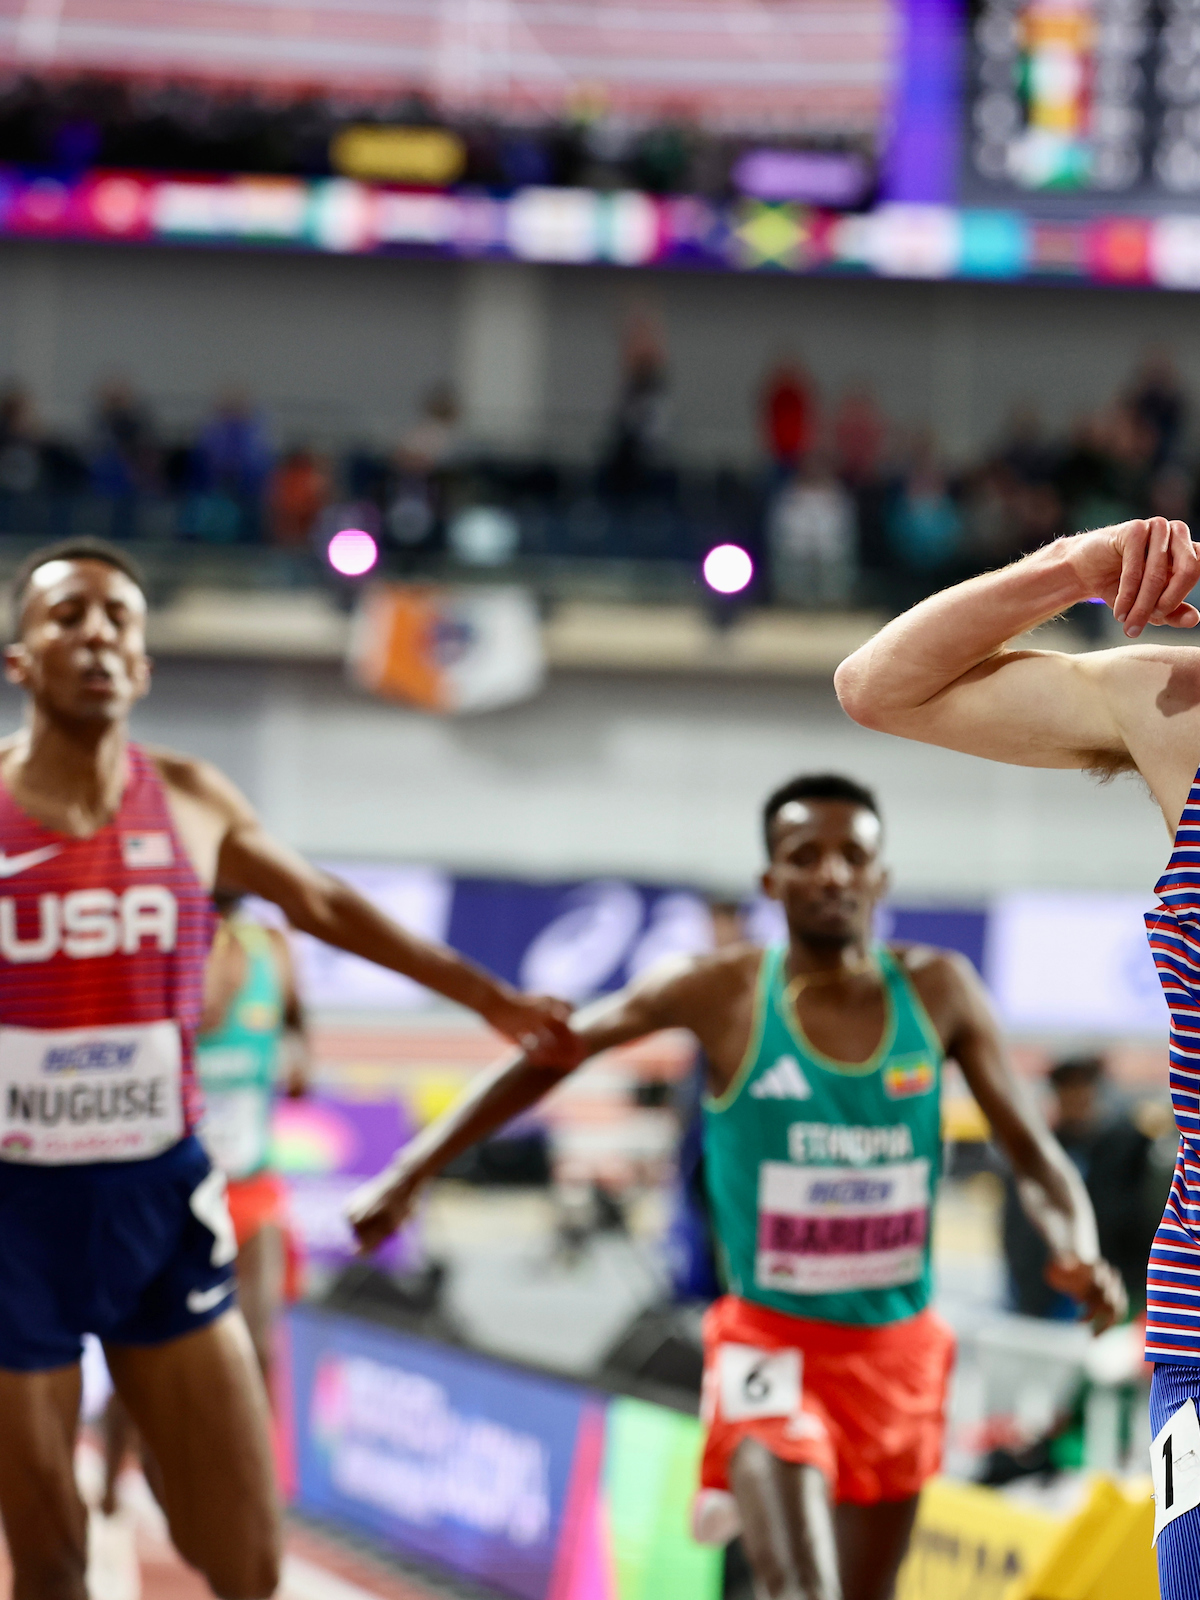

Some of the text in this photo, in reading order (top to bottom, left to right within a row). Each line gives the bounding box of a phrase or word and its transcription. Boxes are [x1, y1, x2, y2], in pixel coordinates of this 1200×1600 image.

[0, 885, 178, 962] USA
[8, 1078, 165, 1126] NUGUSE
[743, 1356, 771, 1402] 6
[1161, 1433, 1174, 1510] 1
